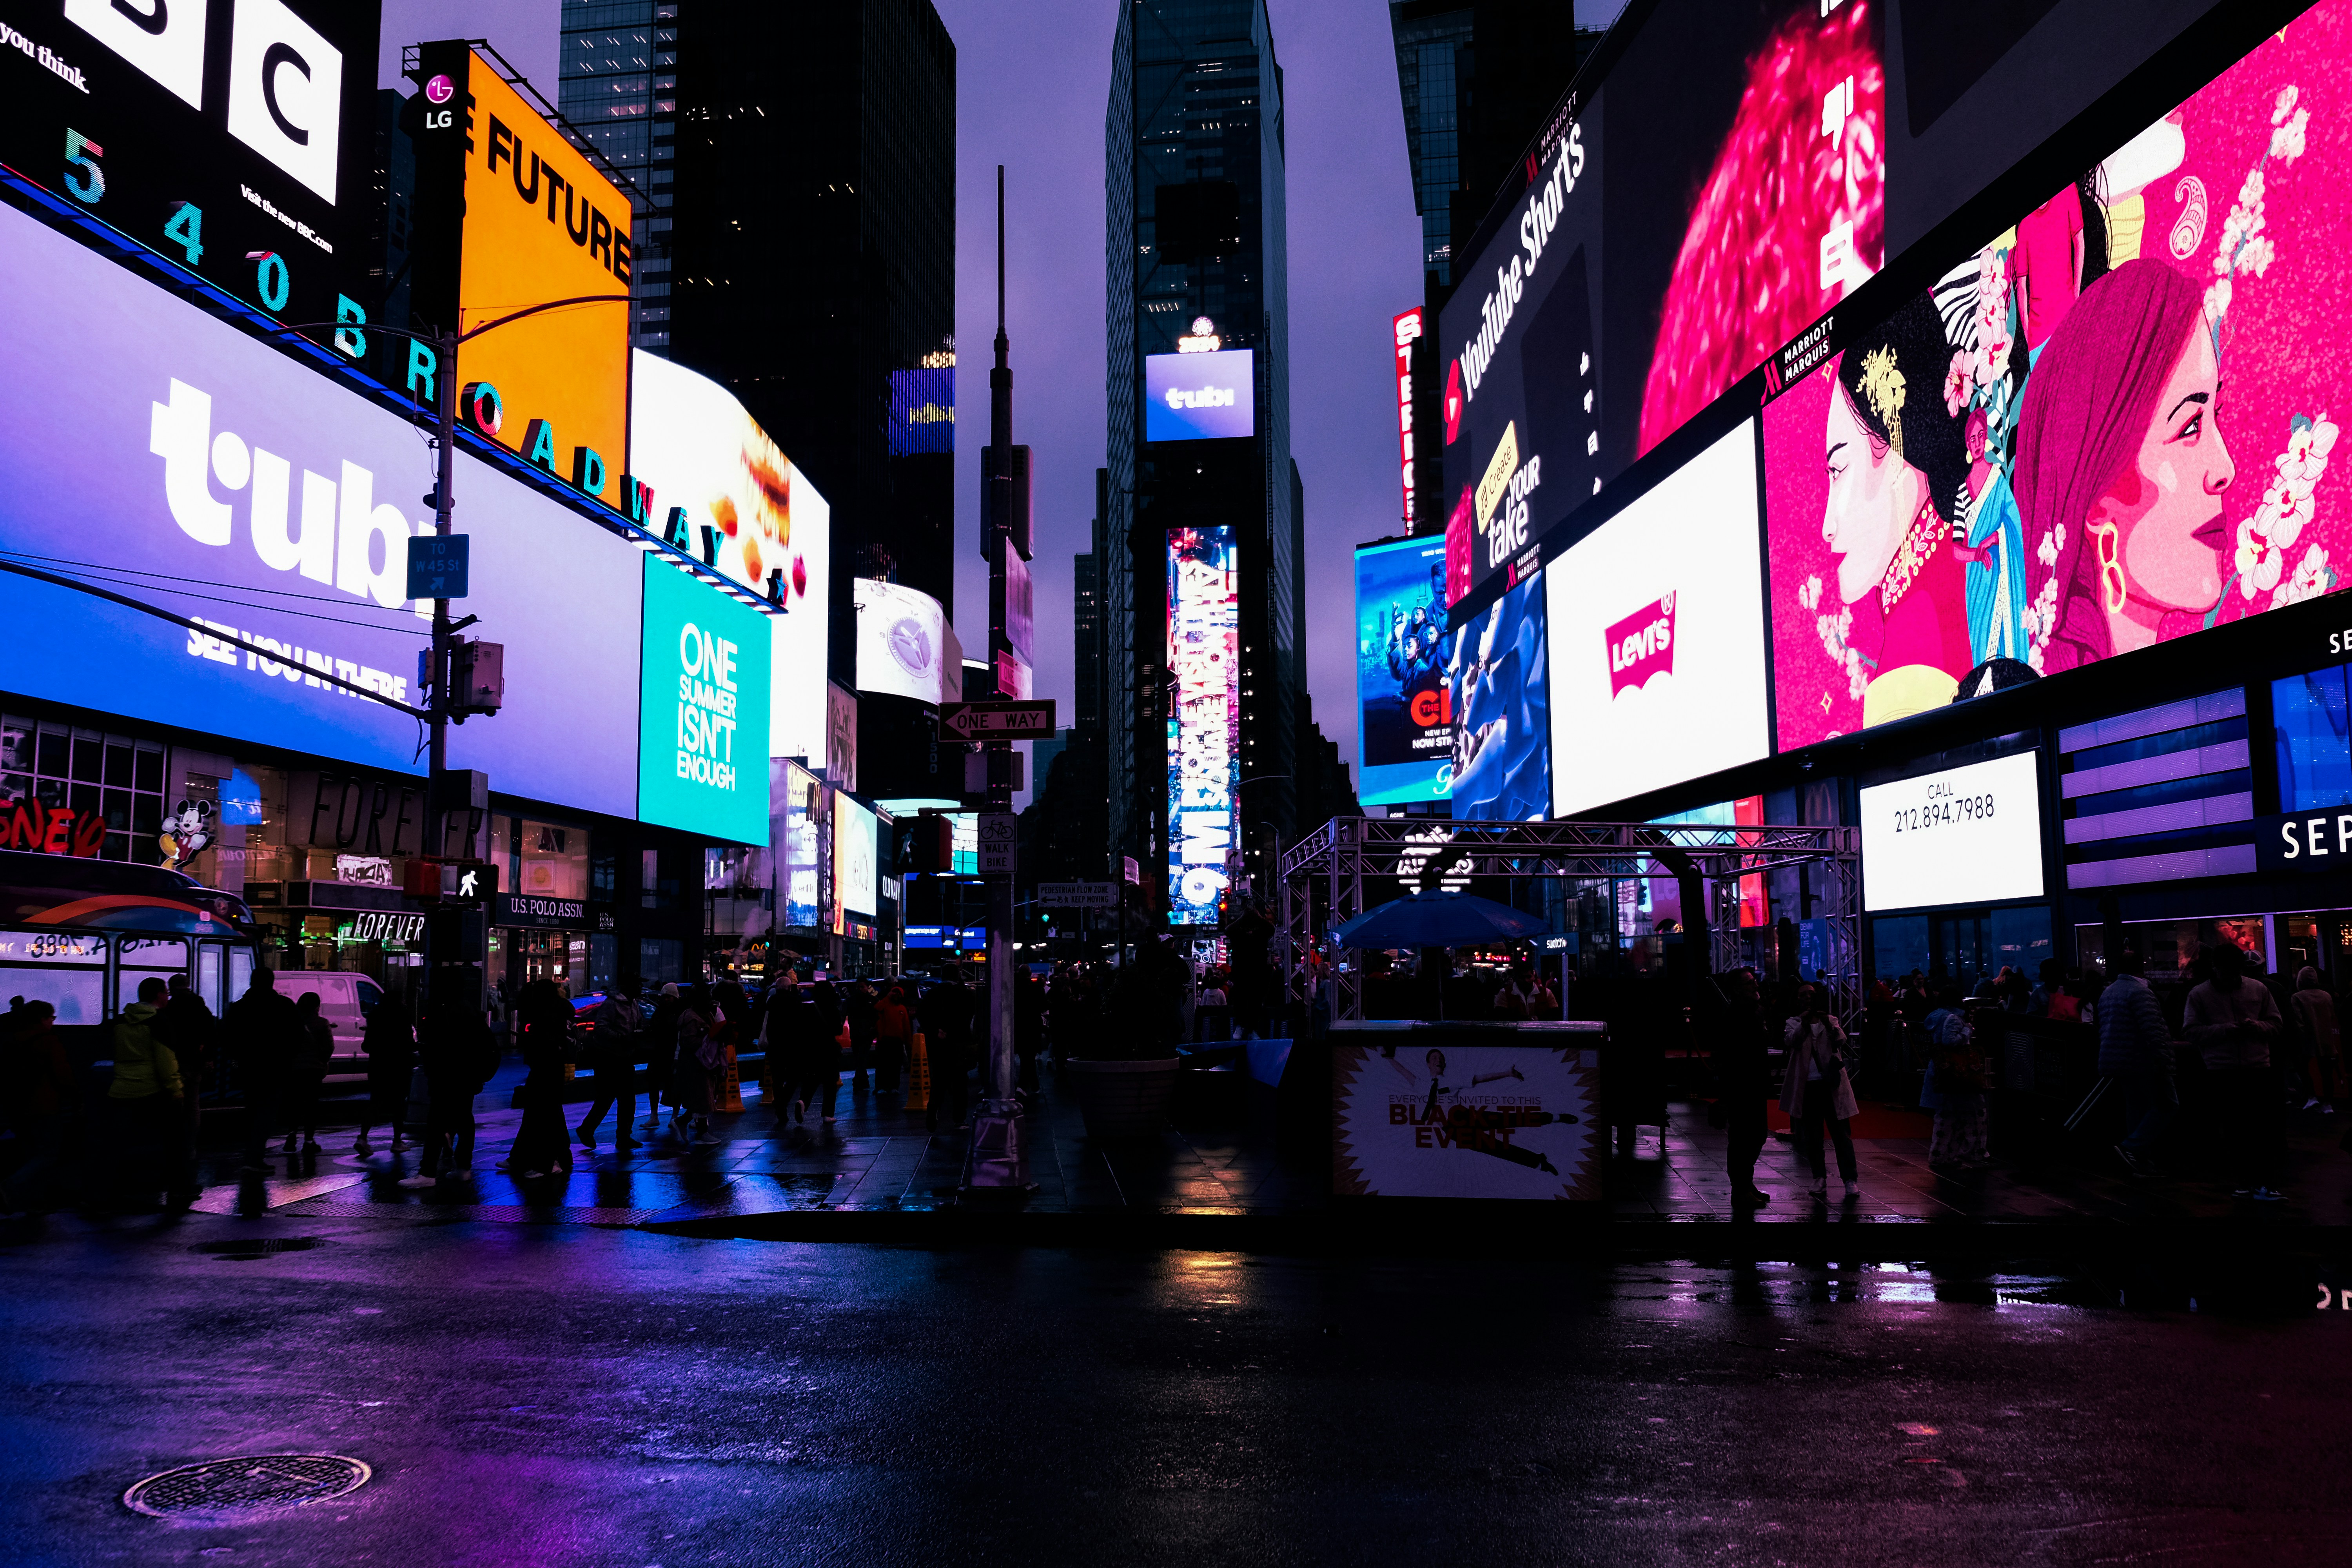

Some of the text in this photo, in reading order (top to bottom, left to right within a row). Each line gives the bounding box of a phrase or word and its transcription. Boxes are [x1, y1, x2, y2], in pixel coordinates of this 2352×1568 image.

[426, 111, 452, 129] LG
[1541, 91, 1577, 151] MARRIOTT
[241, 184, 333, 254] Visit the new BBC.com
[488, 112, 631, 287] FUTURE
[1460, 123, 1585, 402] YouTube Shorts
[1784, 317, 1834, 364] MARRIOTT
[1786, 339, 1829, 381] MARQUIS
[1165, 386, 1234, 409] tubi
[1489, 445, 1512, 495] Create
[1509, 455, 1541, 508] YOUR
[430, 543, 445, 555] TO
[1488, 497, 1528, 568] take
[416, 559, 459, 572] W 45 St
[1517, 543, 1540, 567] MARRIOTT
[1517, 558, 1538, 580] MARQUIS
[187, 616, 238, 666] SEE
[241, 630, 300, 681] YOU
[305, 645, 332, 691] IN
[680, 622, 738, 693] ONE
[679, 674, 737, 719] SUMMER
[1421, 703, 1439, 713] THE
[678, 701, 737, 762] ISN'T
[958, 712, 1040, 729] ONE WAY
[929, 731, 938, 774] 1500
[1180, 704, 1205, 807] PEOPLE
[1204, 697, 1230, 806] SQUARE
[1412, 737, 1435, 749] NOW
[677, 749, 736, 791] ENOUGH
[1928, 782, 1953, 800] CALL
[309, 771, 483, 857] FOREER
[1895, 794, 1994, 833] 212.894.7988
[984, 843, 1009, 854] WALK
[986, 857, 1007, 867] BIKE
[354, 913, 425, 941] FOREVER
[511, 898, 584, 918] U.S. POLO ASSN.
[1546, 937, 1563, 949] swatch
[1389, 1104, 1541, 1127] BLACK-TIE
[1455, 1094, 1498, 1104] INVITED
[1501, 1096, 1515, 1104] TO
[1517, 1096, 1541, 1105] THIS
[1415, 1127, 1515, 1149] EVENT
